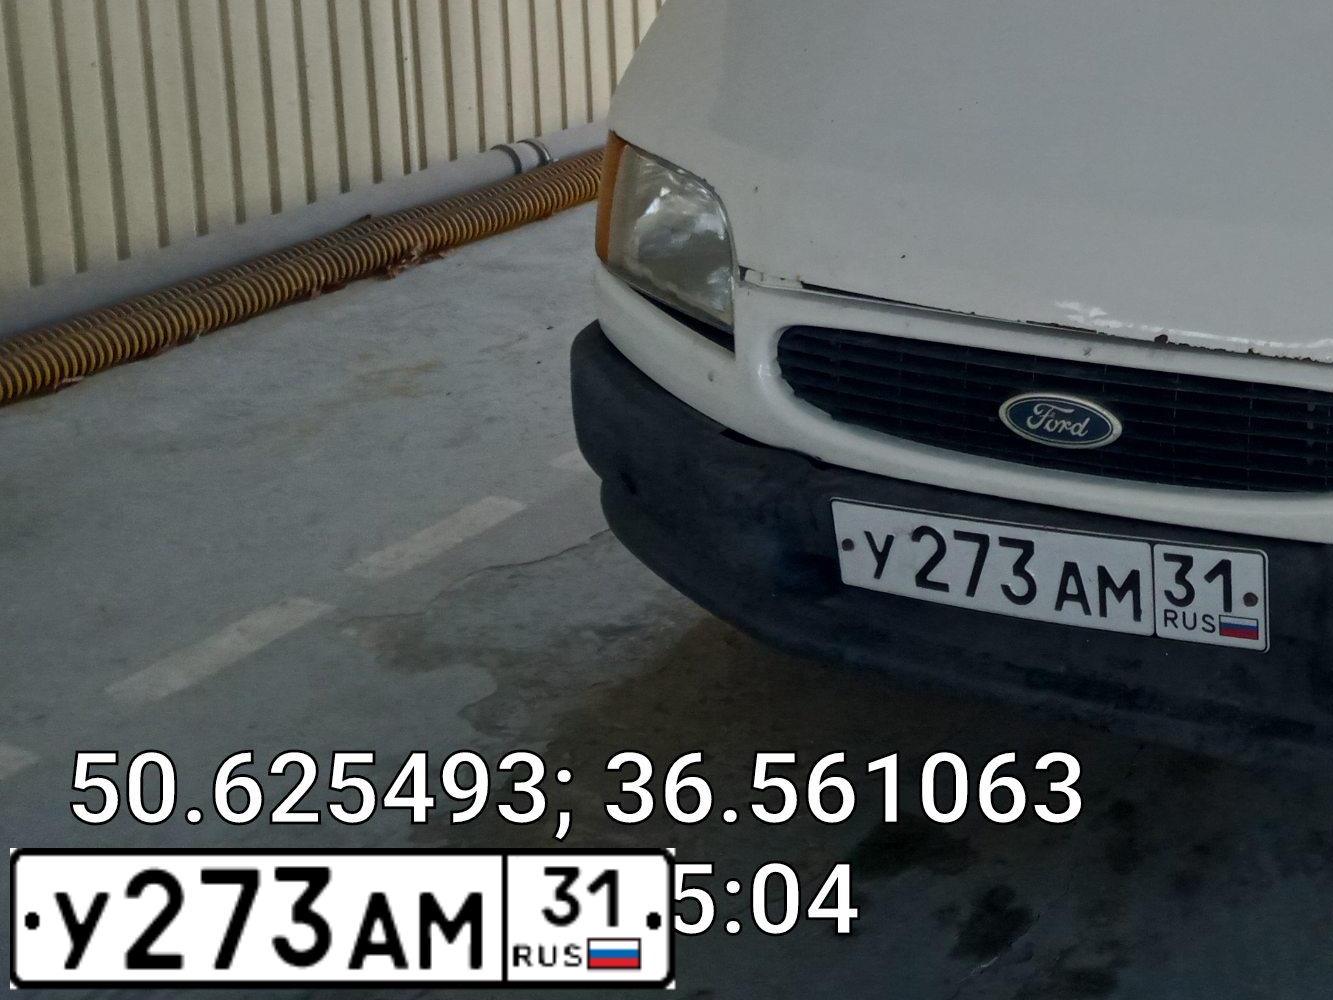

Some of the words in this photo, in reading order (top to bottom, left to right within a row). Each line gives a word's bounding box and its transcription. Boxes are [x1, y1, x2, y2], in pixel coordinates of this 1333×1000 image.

[1027, 402, 1089, 438] Ford
[1163, 553, 1233, 613] 31
[1163, 609, 1216, 633] RUS
